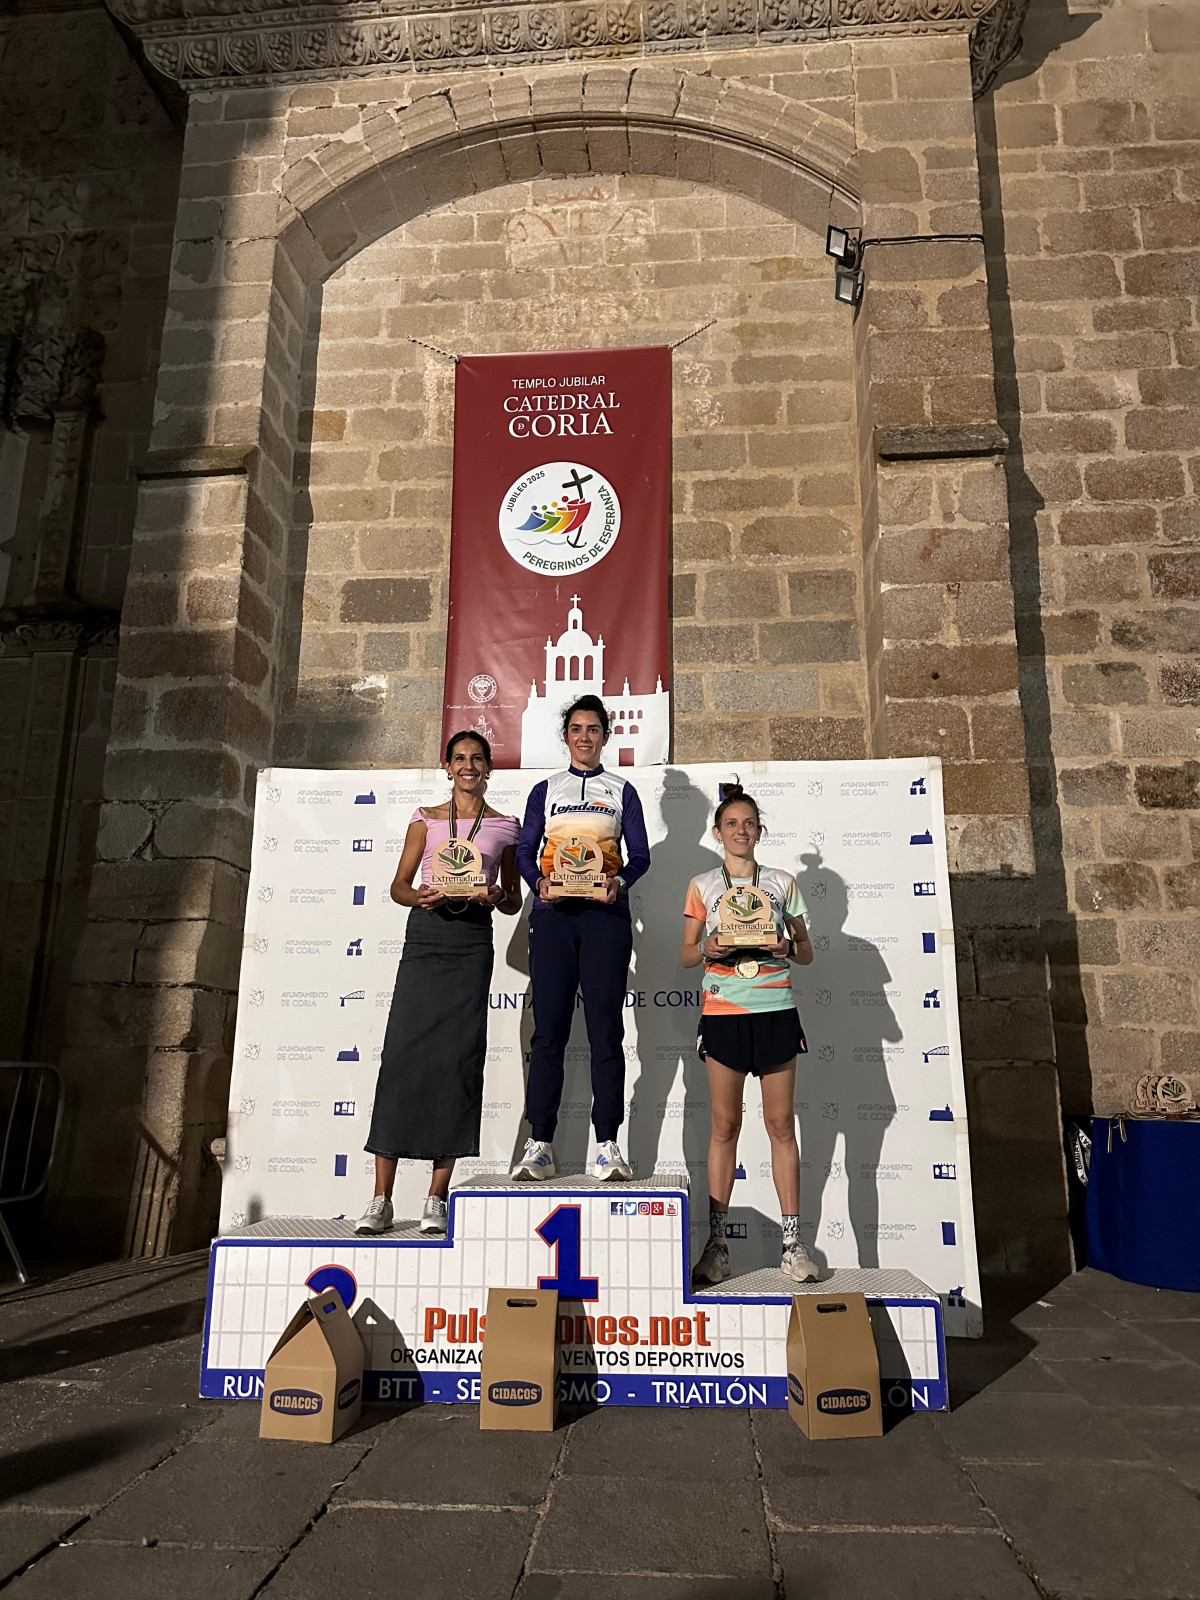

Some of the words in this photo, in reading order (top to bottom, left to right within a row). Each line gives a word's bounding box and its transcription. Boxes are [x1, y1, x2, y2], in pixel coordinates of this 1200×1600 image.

[512, 378, 556, 389] TEMPLO
[559, 376, 605, 387] JUBILAR
[503, 392, 620, 412] CATEDRAL
[509, 412, 614, 438] CORIA
[505, 482, 527, 512] JUBILEO
[527, 471, 546, 485] 2025
[523, 551, 590, 570] PEREGRINOS
[589, 544, 604, 557] DE
[597, 484, 615, 546] ESPERANZA
[841, 788, 852, 796] DE
[853, 788, 876, 796] CORIA
[551, 802, 616, 817] Lojadama
[281, 999, 291, 1007] DE
[293, 999, 317, 1007] CORIA
[376, 999, 385, 1007] DE
[625, 992, 646, 1007] DE
[654, 991, 703, 1007] CORI
[277, 1053, 288, 1061] DE
[289, 1053, 313, 1061] CORIA
[868, 1055, 893, 1063] CORIA
[284, 1109, 308, 1117] CORIA
[669, 1110, 695, 1118] CORIA
[858, 1112, 870, 1121] DE
[872, 1112, 897, 1121] CORIA
[268, 1165, 279, 1173] DE
[280, 1165, 304, 1173] CORIA
[876, 1172, 901, 1180] CORIA
[864, 1232, 876, 1240] DE
[879, 1232, 904, 1240] CORIA
[535, 1204, 599, 1302] 1
[561, 1351, 630, 1367] VENTOS
[635, 1351, 744, 1369] DEPORTIVOS
[379, 1378, 417, 1399] BTT
[652, 1377, 767, 1405] TRIATLÓN
[492, 1387, 538, 1400] CIDACOS
[274, 1395, 319, 1409] CIDACOS
[820, 1396, 867, 1409] CIDACOS
